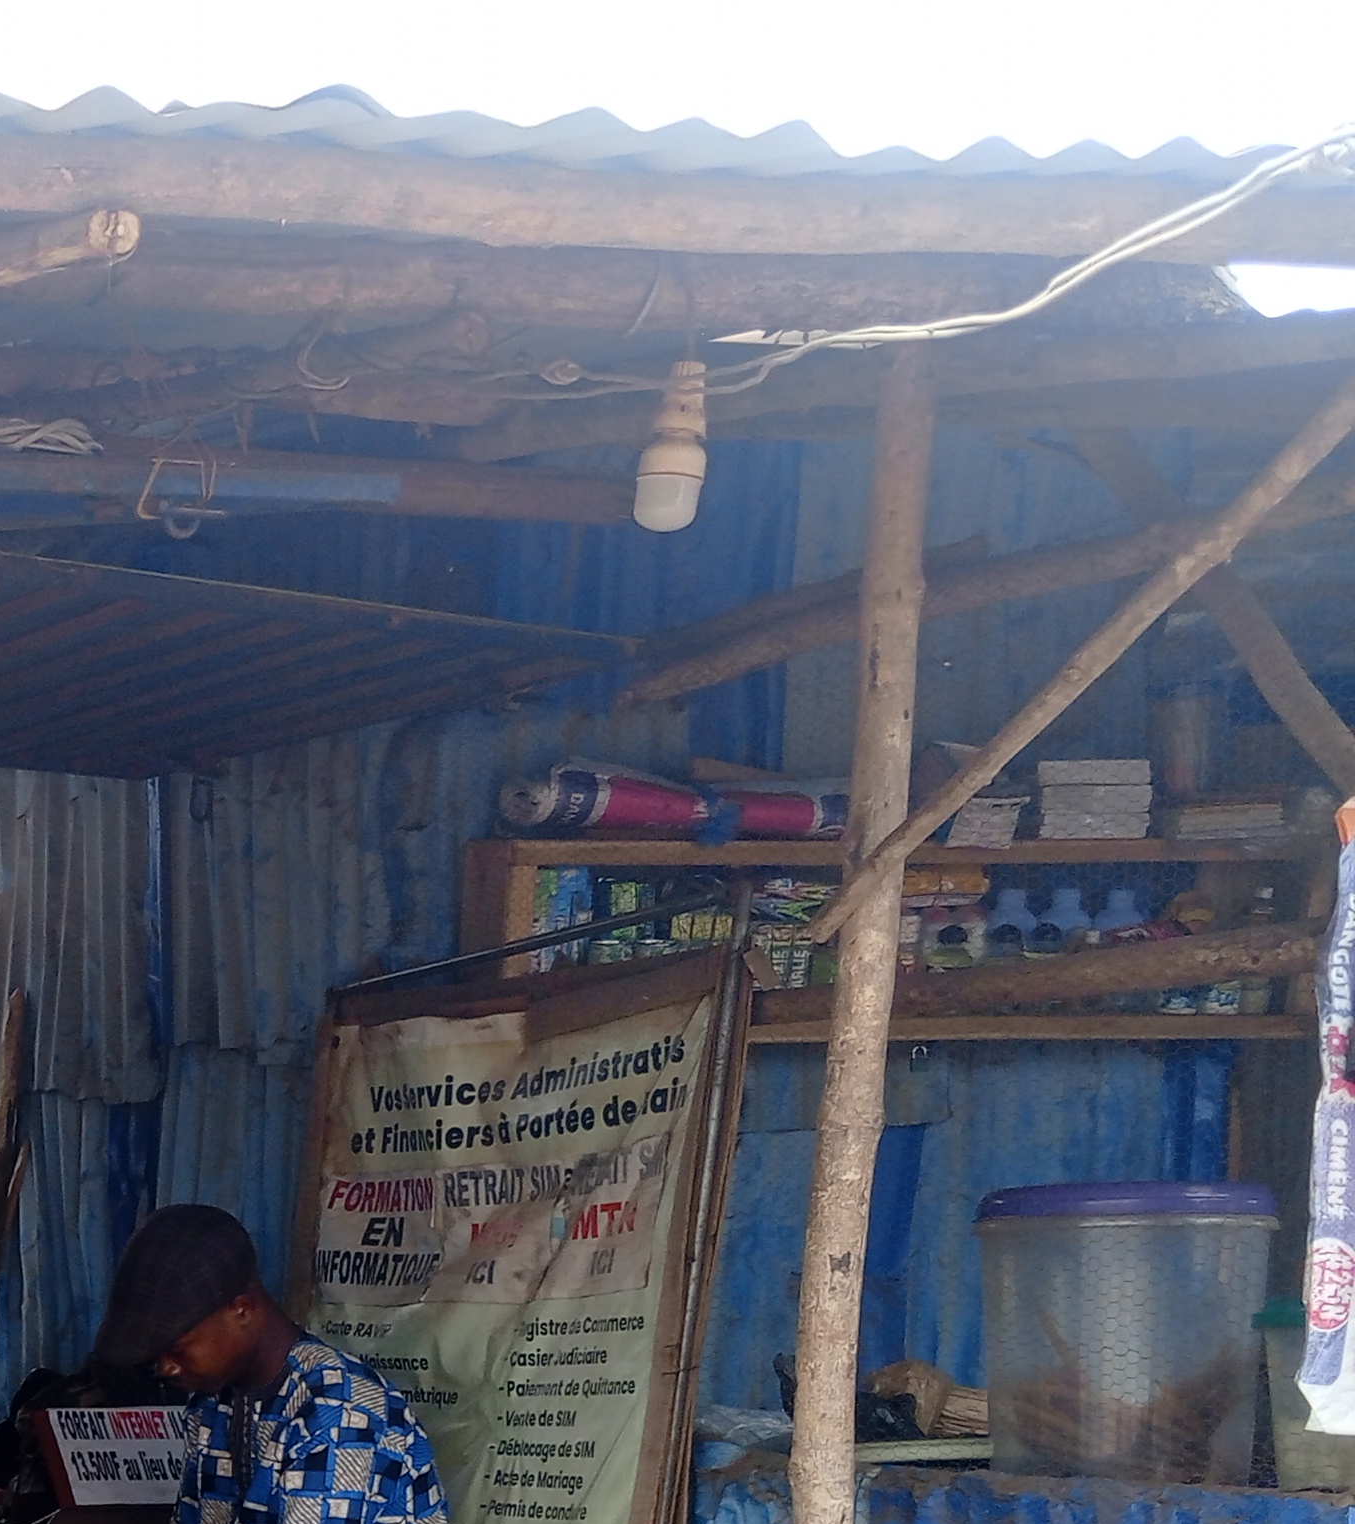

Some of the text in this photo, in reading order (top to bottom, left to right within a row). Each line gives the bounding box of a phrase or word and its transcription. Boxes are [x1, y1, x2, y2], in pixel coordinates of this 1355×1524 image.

[350, 1130, 377, 1156] et
[515, 1099, 596, 1143] Portée
[602, 1092, 637, 1128] de
[643, 1078, 691, 1116] ain
[1327, 1117, 1349, 1221] CIMENT
[327, 1164, 561, 1214] FORMATION RETRAIT SIM
[360, 1200, 639, 1248] EN MTN
[582, 1314, 645, 1335] Commerce
[56, 1410, 170, 1441] FORFAIT INTERNET
[538, 1409, 554, 1427] de
[555, 1409, 577, 1428] SIM
[557, 1440, 573, 1458] de
[574, 1441, 596, 1459] SIM
[520, 1473, 535, 1488] de
[536, 1472, 584, 1495] Mariage
[527, 1503, 543, 1519] de
